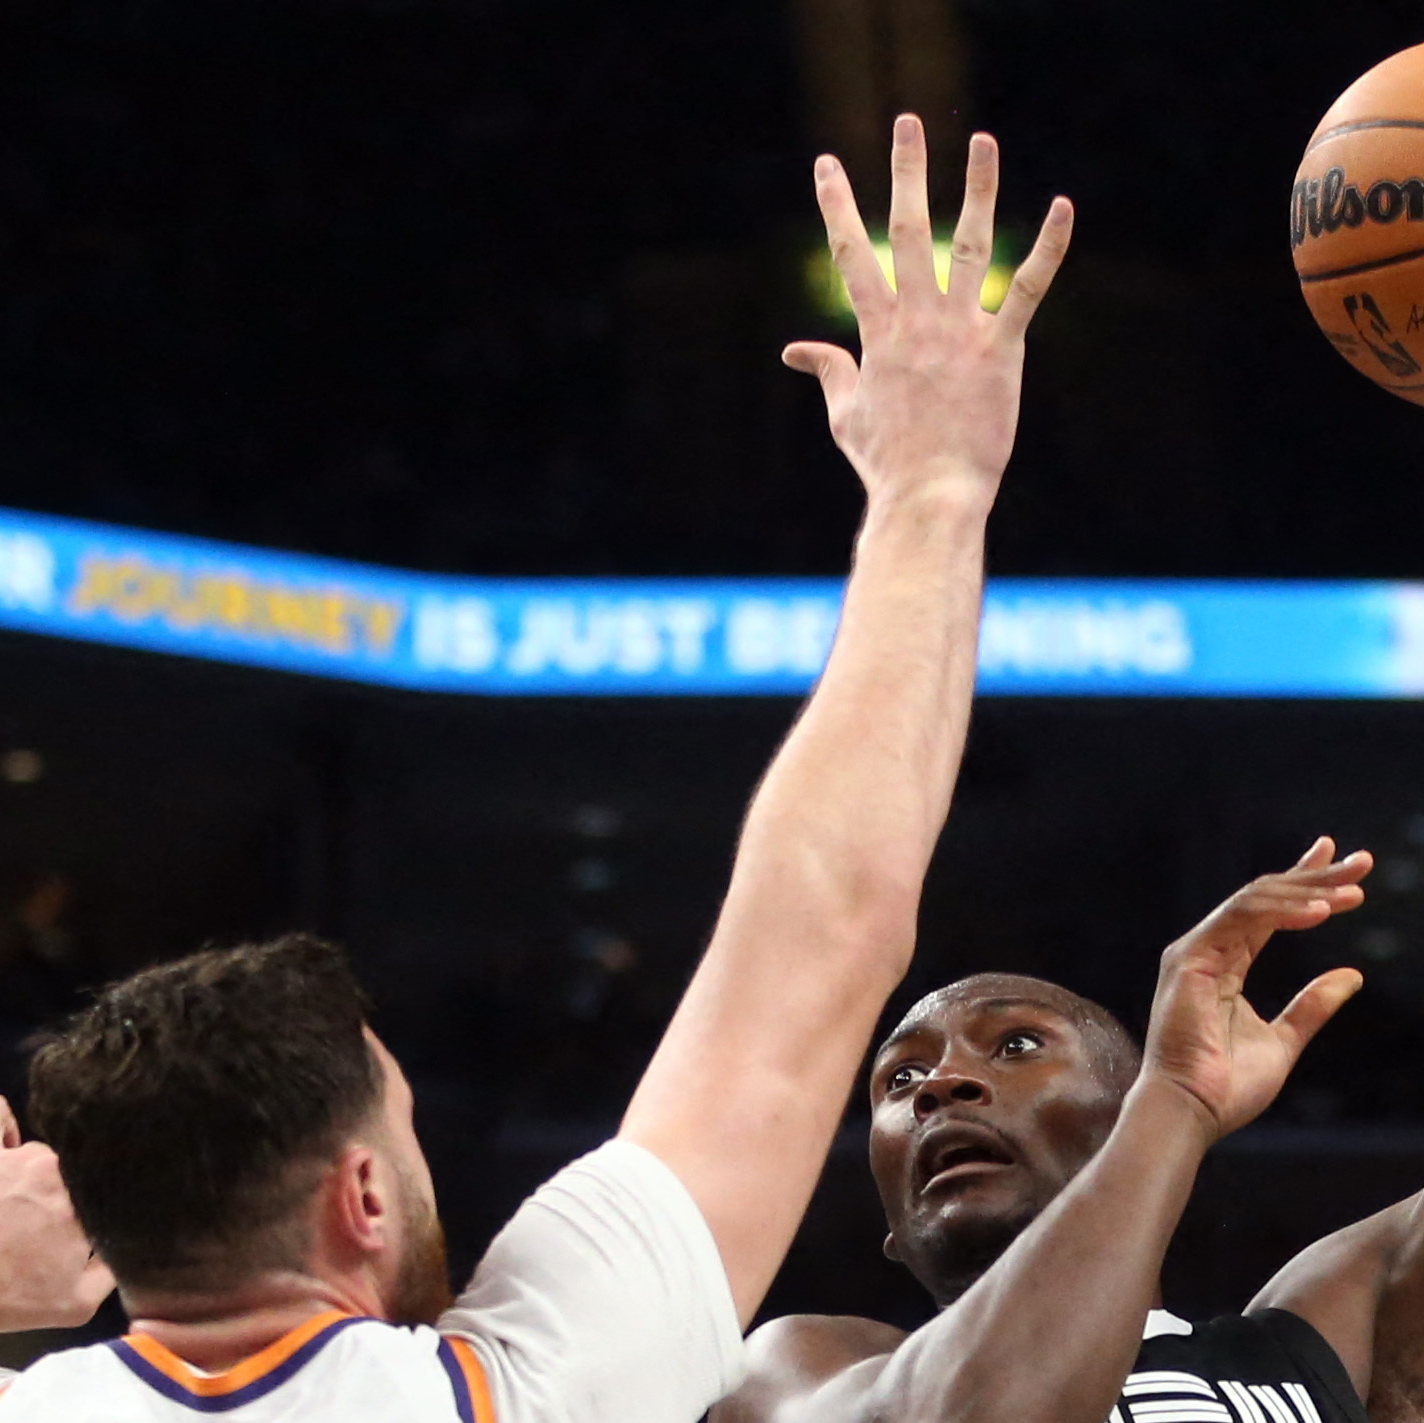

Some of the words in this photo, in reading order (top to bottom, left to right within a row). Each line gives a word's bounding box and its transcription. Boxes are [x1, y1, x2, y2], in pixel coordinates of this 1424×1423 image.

[68, 553, 402, 656] JOURNEY
[412, 598, 498, 672] IS
[507, 598, 711, 674] JUST
[724, 598, 1192, 676] BENING
